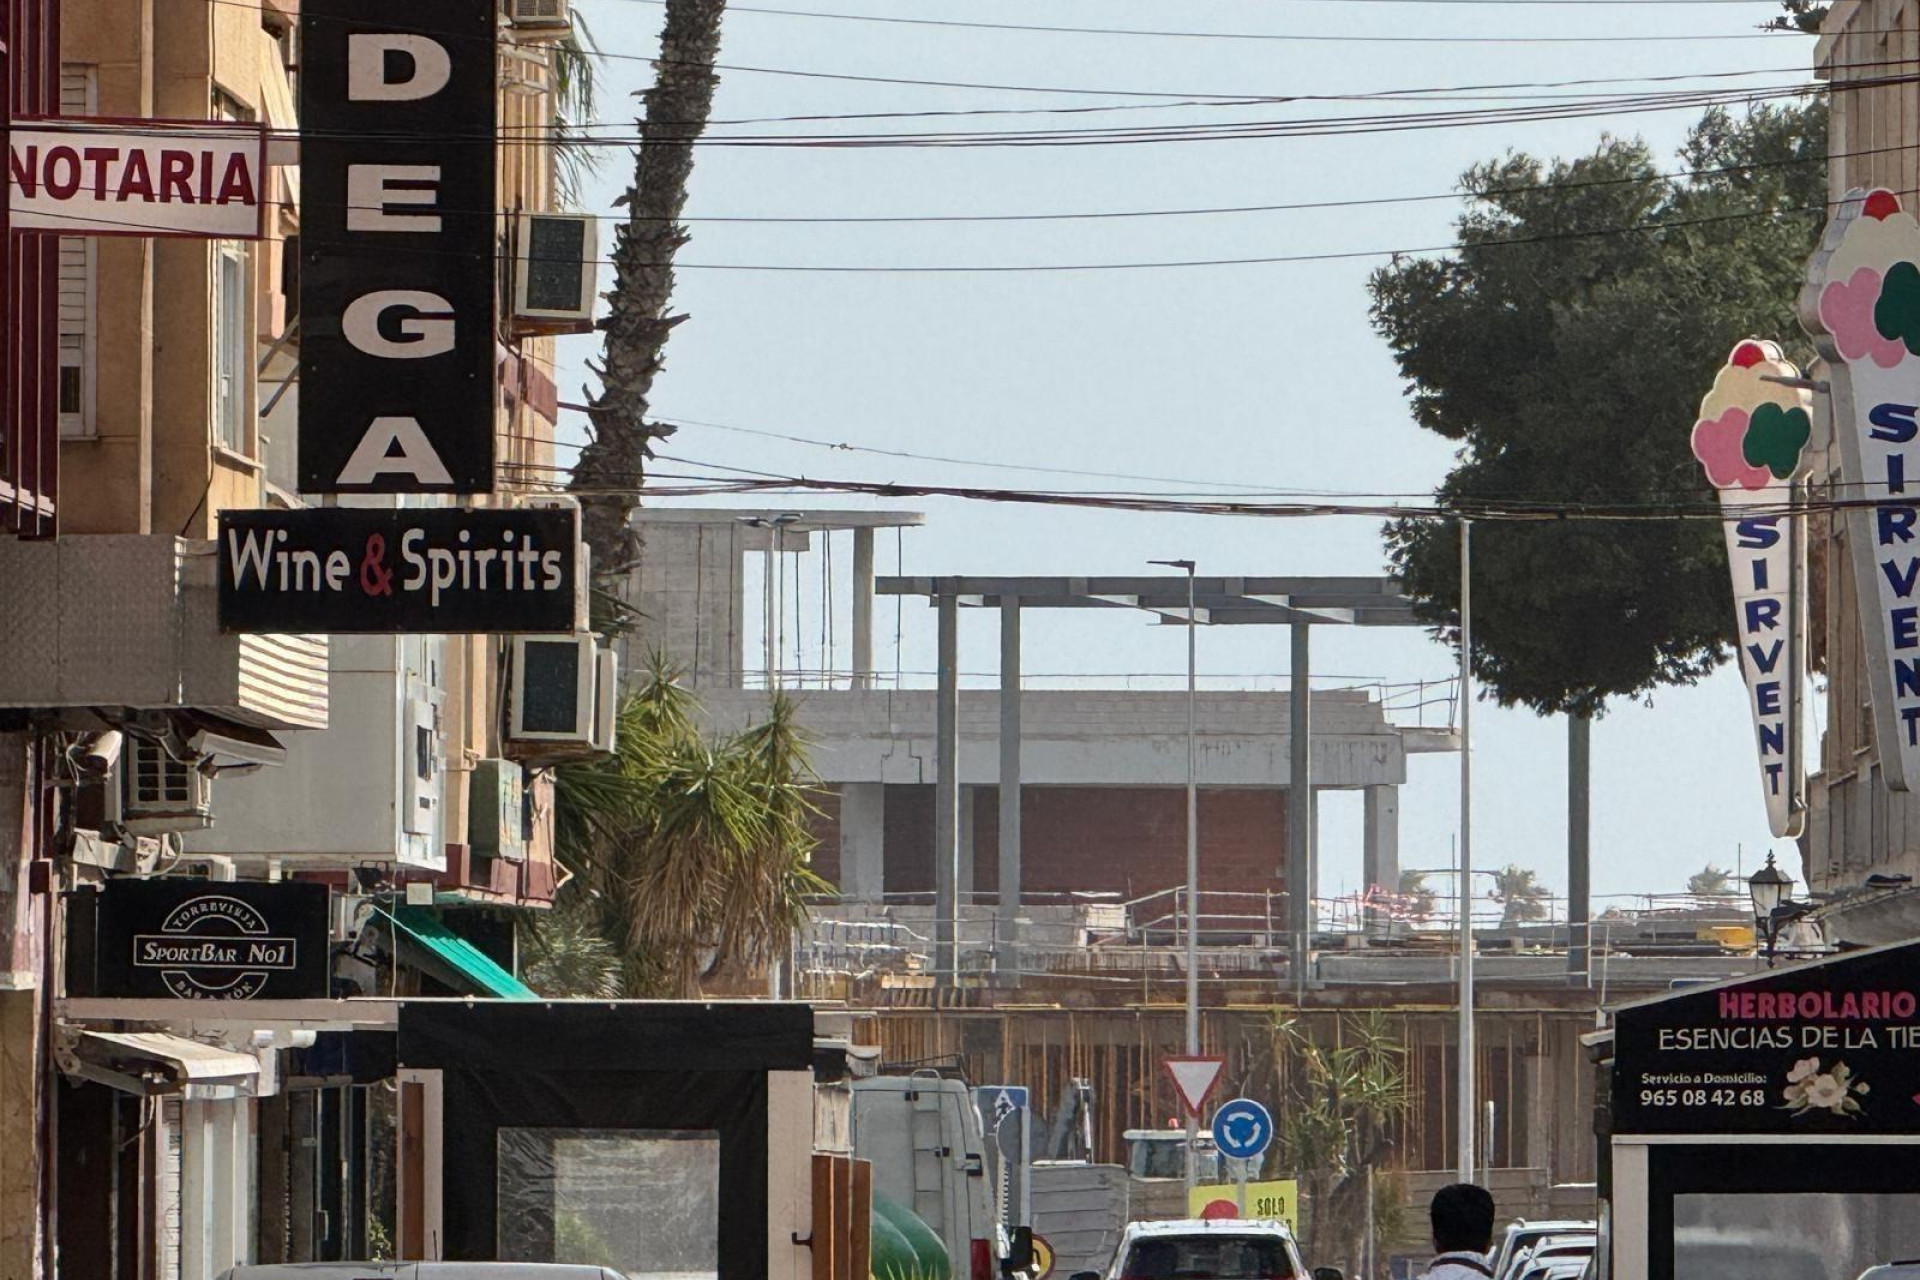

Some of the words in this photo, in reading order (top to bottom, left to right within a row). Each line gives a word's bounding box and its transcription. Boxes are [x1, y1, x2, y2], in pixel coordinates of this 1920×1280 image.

[11, 145, 256, 206] NOTARIA
[336, 34, 455, 484] DEGA
[228, 528, 350, 591] Wine
[360, 533, 392, 596] &
[401, 528, 562, 606] Spirits
[1868, 403, 1920, 746] SIRVENT
[1736, 517, 1784, 796] SIRVENT
[1719, 991, 1915, 1019] HERBOLARIO
[1659, 1026, 1793, 1050] ESENCIAS
[1802, 1026, 1838, 1048] DE
[1844, 1027, 1877, 1049] LA
[1640, 1089, 1677, 1106] 965
[1682, 1089, 1706, 1106] 08
[1710, 1089, 1736, 1106] 42
[1740, 1089, 1765, 1106] 68
[1641, 1072, 1692, 1085] Servicio
[1693, 1074, 1700, 1084] a
[1257, 1197, 1285, 1217] SOLO
